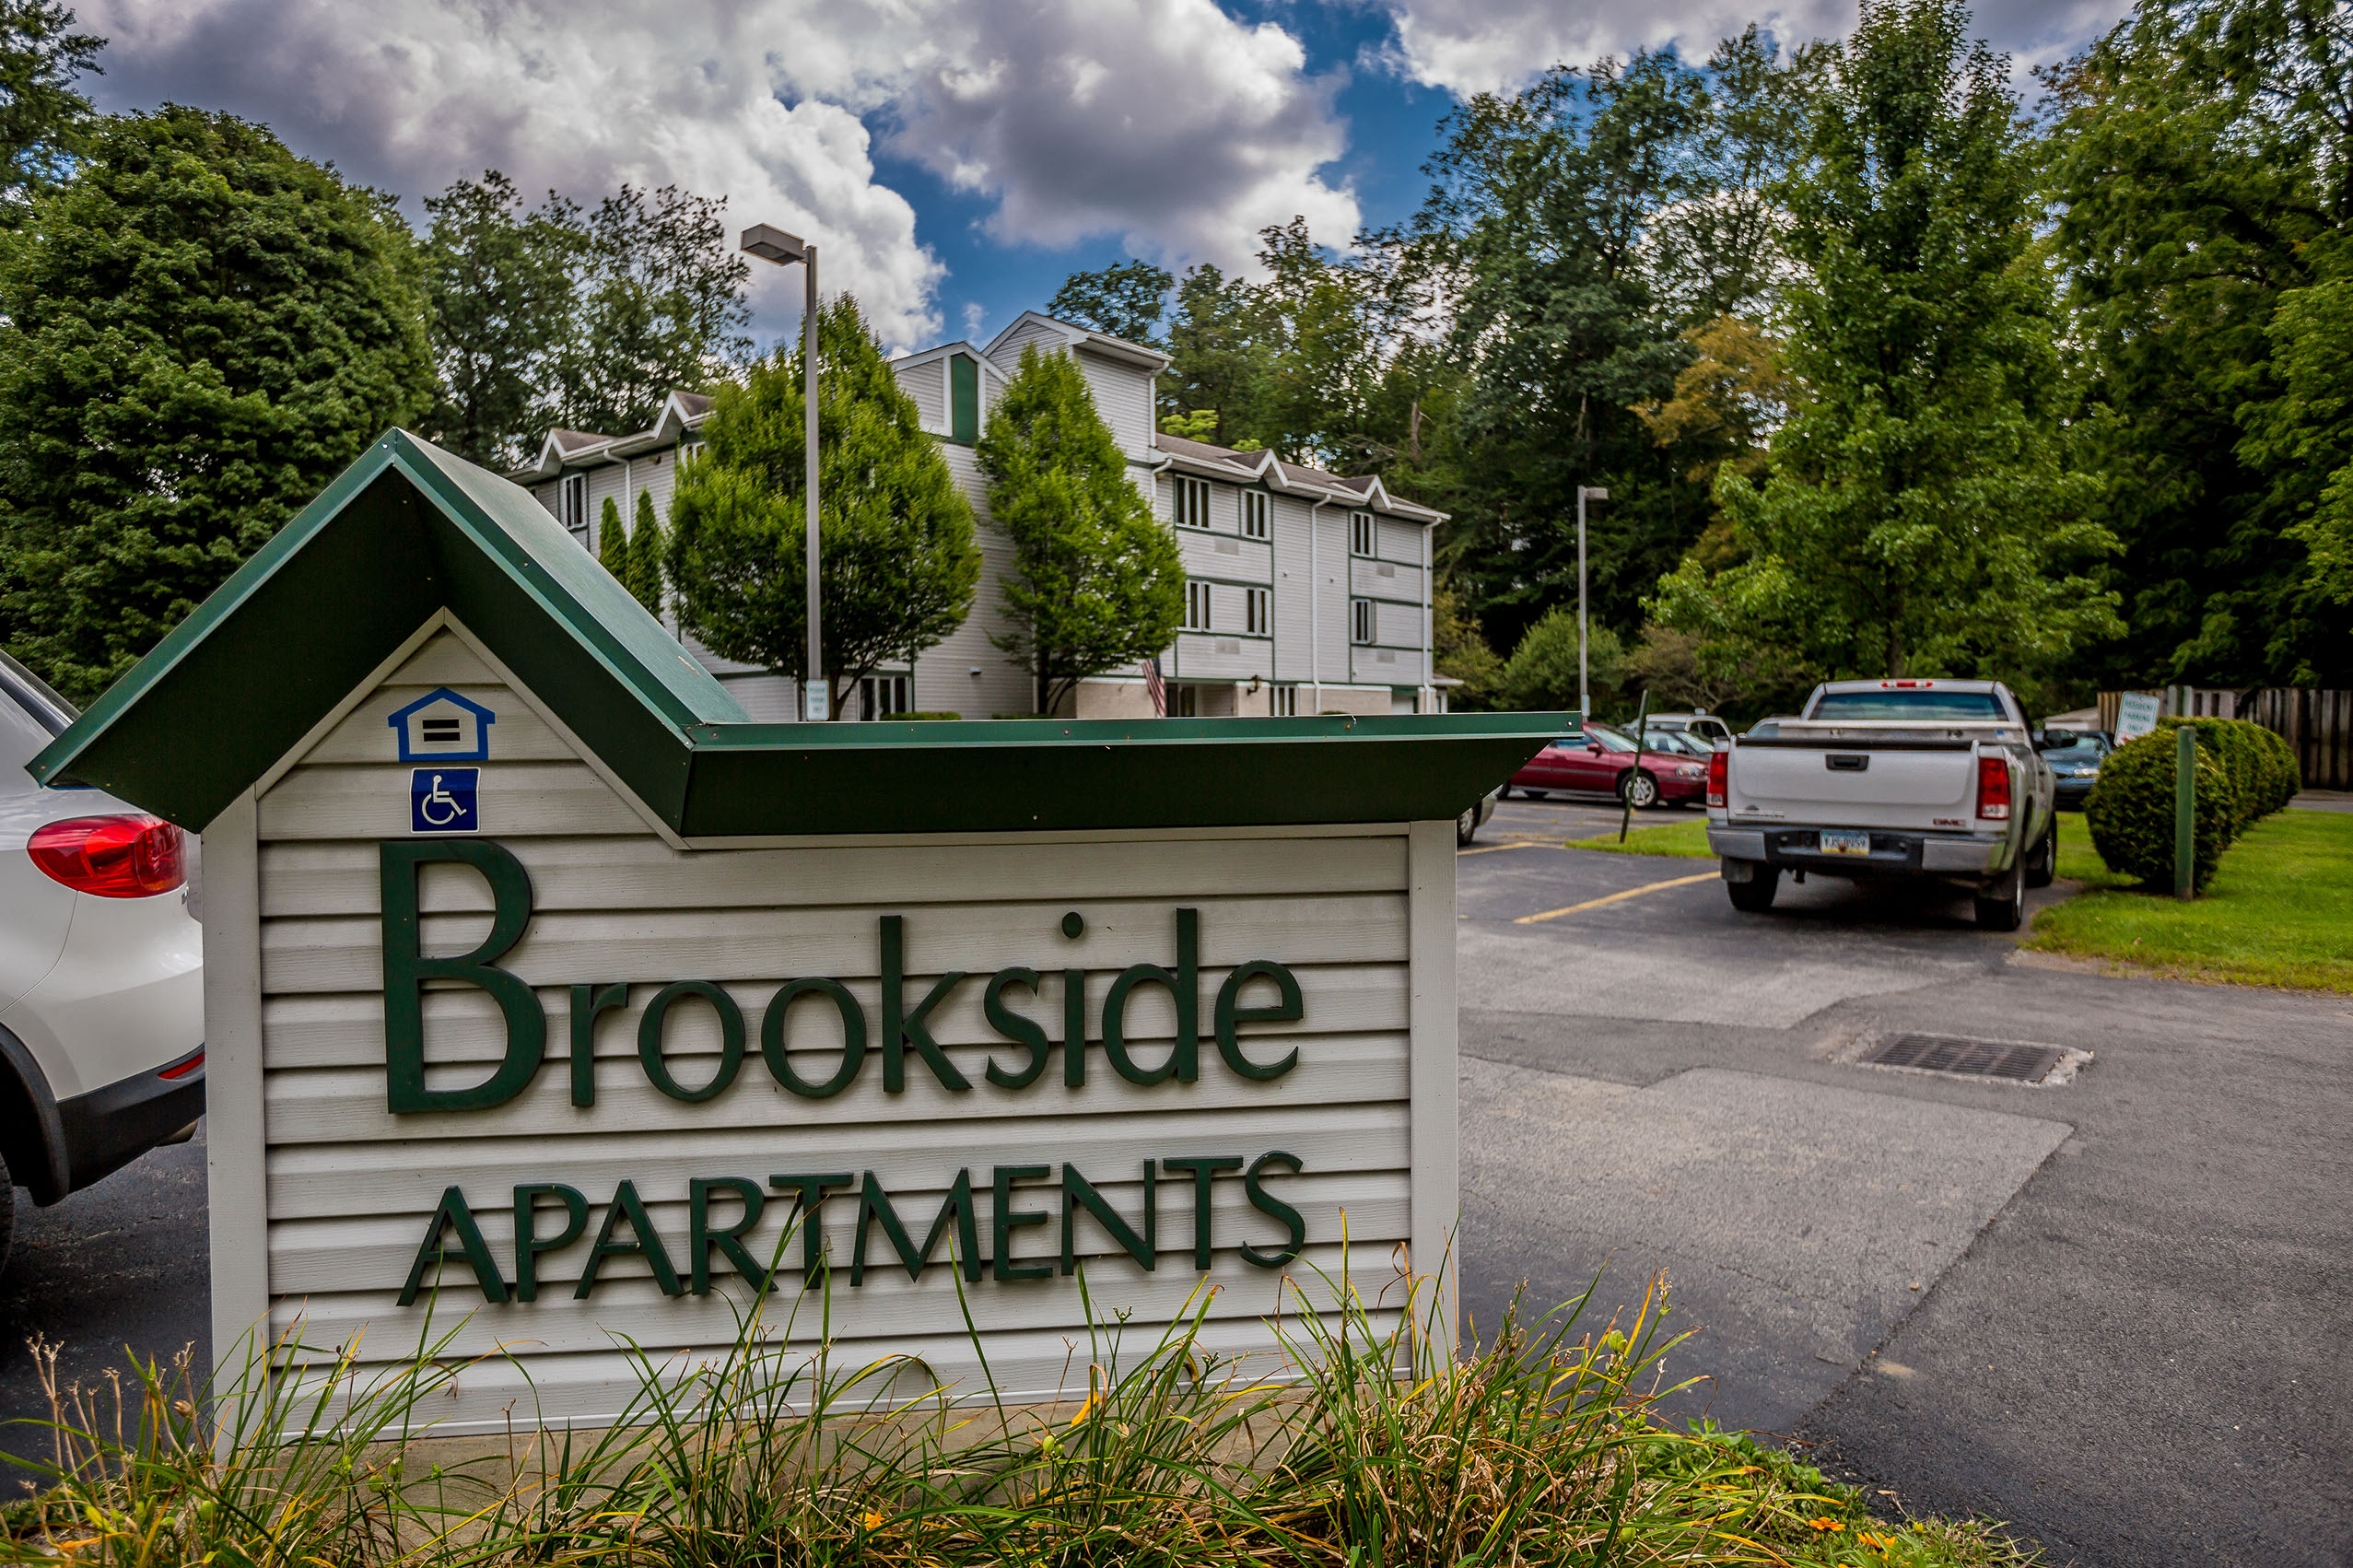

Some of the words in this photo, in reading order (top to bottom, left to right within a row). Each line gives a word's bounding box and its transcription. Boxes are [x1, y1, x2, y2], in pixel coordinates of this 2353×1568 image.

[1932, 817, 1967, 827] GMC
[380, 840, 1305, 1114] Brookside
[396, 1151, 1306, 1307] APARTMENTS
